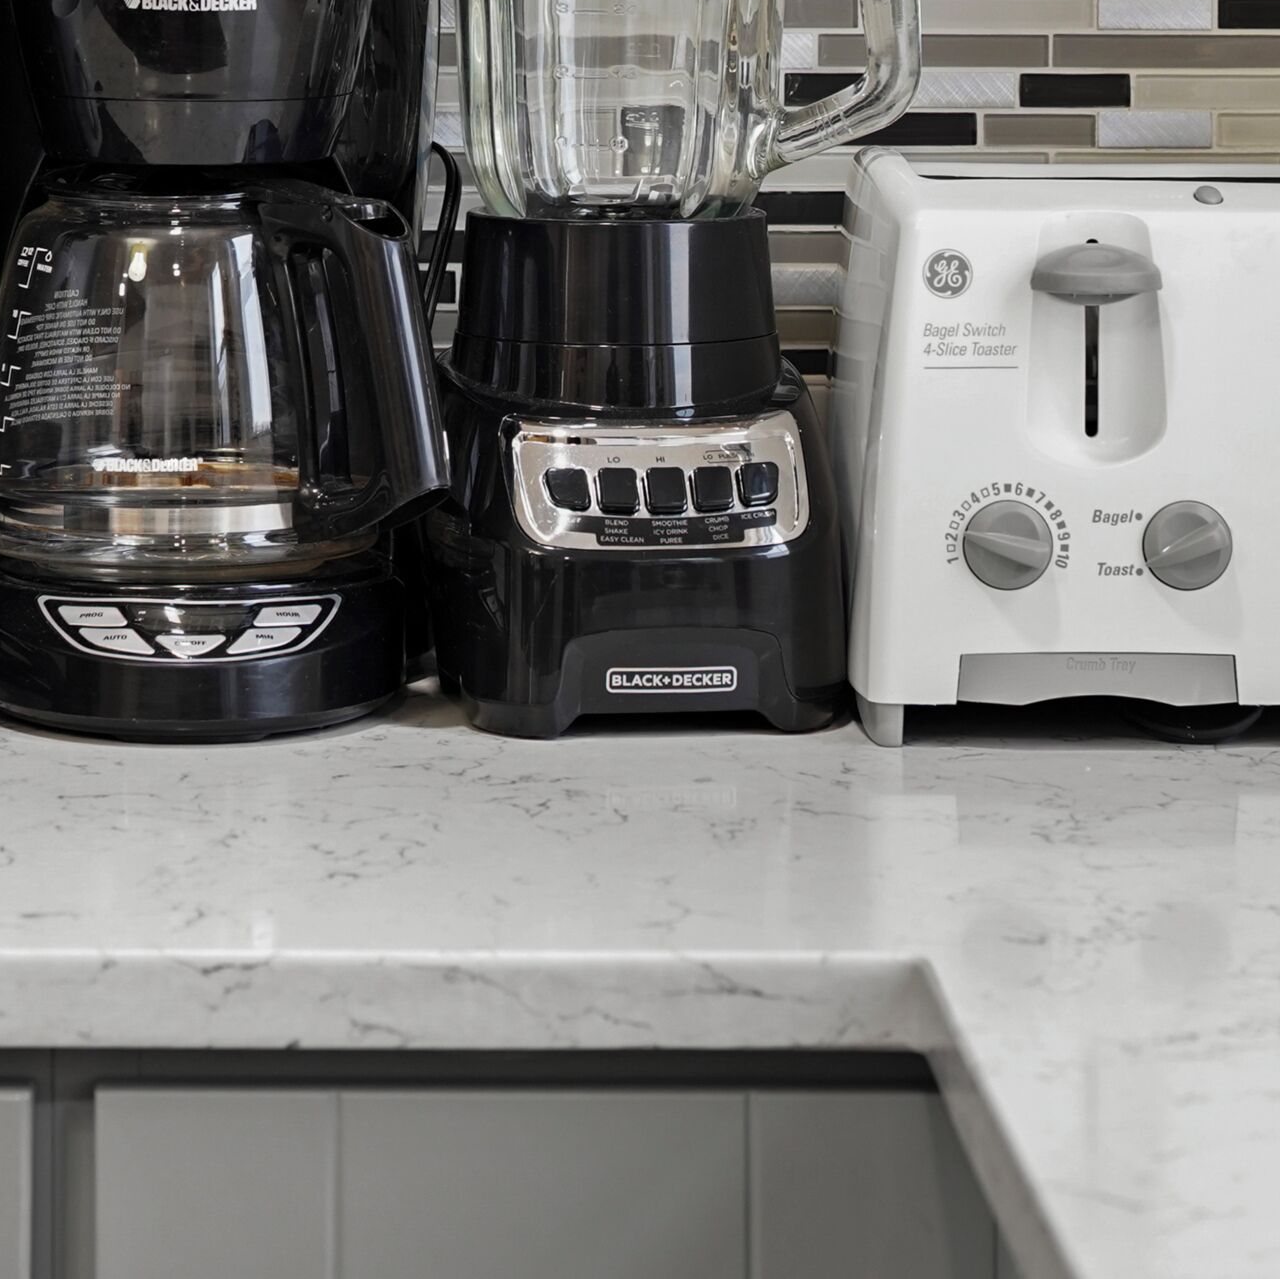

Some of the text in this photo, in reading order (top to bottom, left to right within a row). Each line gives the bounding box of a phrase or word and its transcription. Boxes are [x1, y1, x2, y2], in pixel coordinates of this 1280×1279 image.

[933, 259, 963, 288] GE
[922, 322, 1007, 340] Bagel Switch
[923, 341, 1018, 356] 4-Slice Toaster
[607, 456, 621, 464] LO
[704, 516, 730, 524] CRUMB
[740, 512, 752, 520] ICE
[1091, 509, 1134, 526] Bagel
[604, 519, 629, 527] BLEND
[651, 519, 689, 527] SMOOTHIE
[945, 482, 1071, 569] 1 2 3 4 5 6 7 8 9 10
[652, 528, 689, 536] ICY DRINK
[708, 525, 729, 533] CHOP
[620, 536, 645, 544] CLEAN
[712, 533, 729, 541] DICE
[1097, 562, 1135, 576] Toast
[1065, 656, 1137, 675] Crumb Tray
[611, 673, 732, 687] BLACK+DECKER
